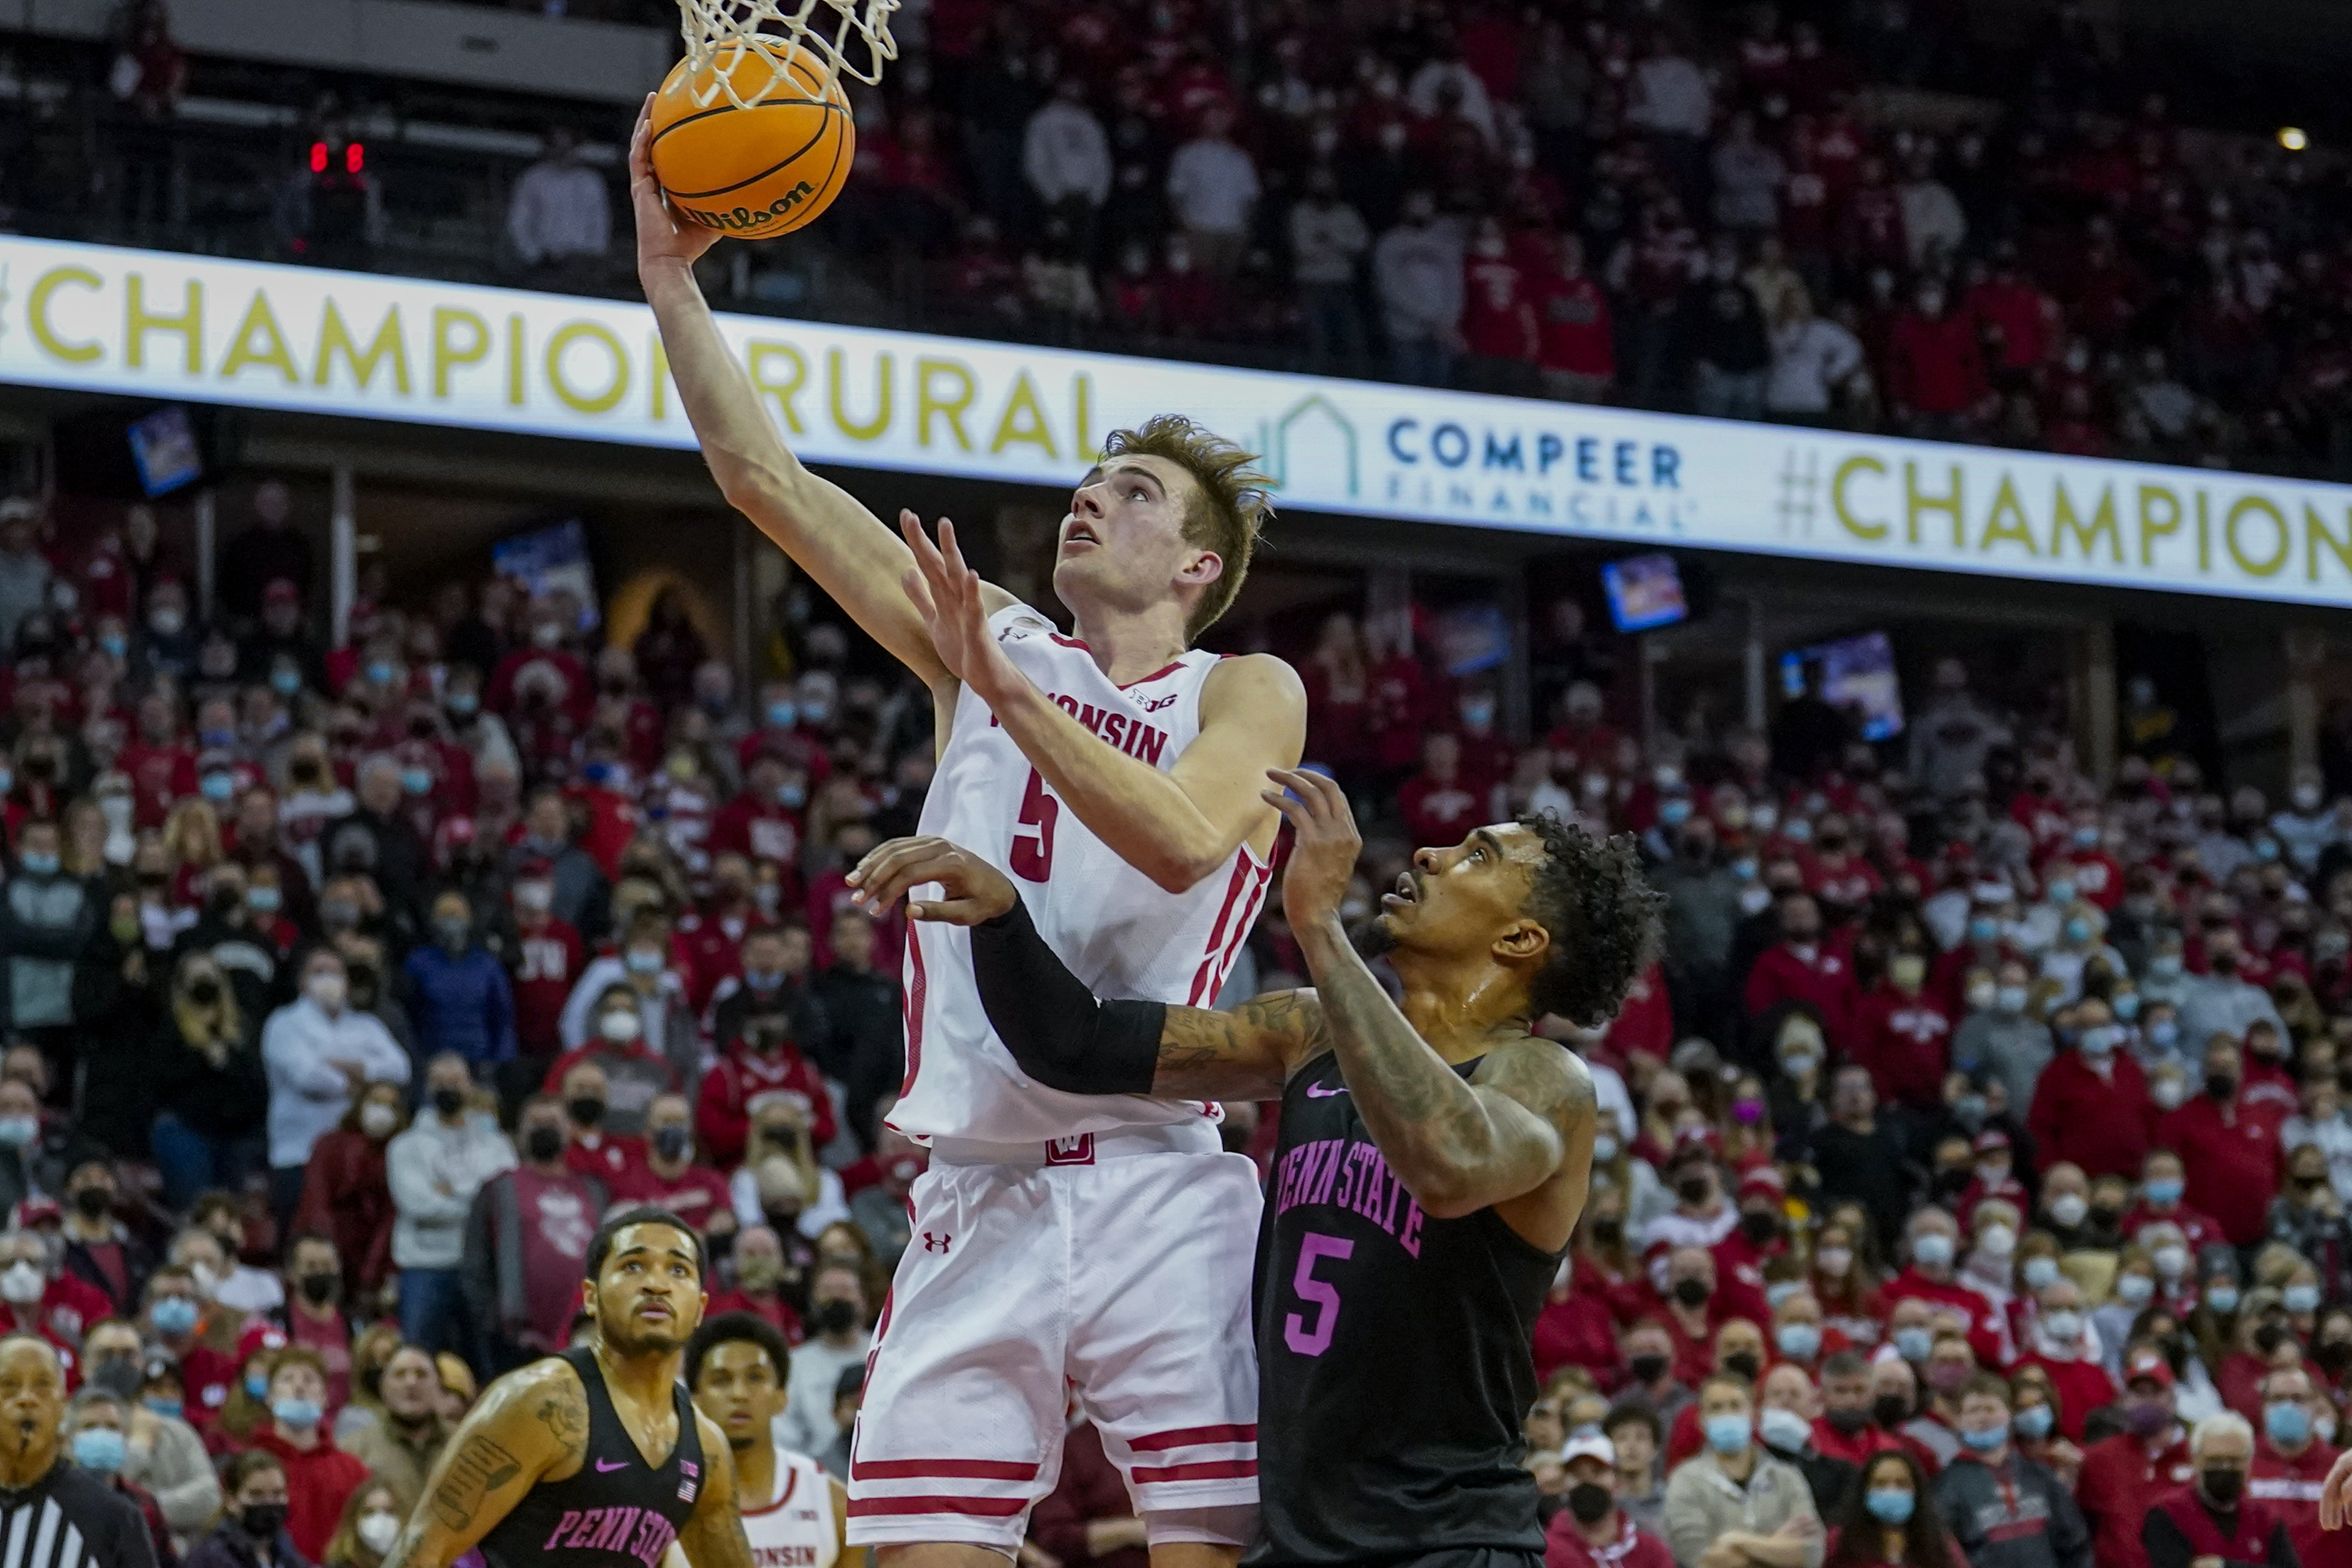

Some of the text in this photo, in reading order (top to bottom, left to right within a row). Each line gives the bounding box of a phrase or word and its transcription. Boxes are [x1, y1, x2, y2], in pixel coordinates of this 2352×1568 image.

[682, 181, 815, 230] Wilson
[1387, 417, 1681, 489] COMPEER
[1387, 471, 1683, 530] FINANCIAL
[1775, 446, 2352, 581] #CHAMPION
[1009, 765, 1059, 883] 5
[1336, 1141, 1424, 1260] STATE
[1284, 1231, 1354, 1357] 5
[543, 1507, 642, 1552] PENN
